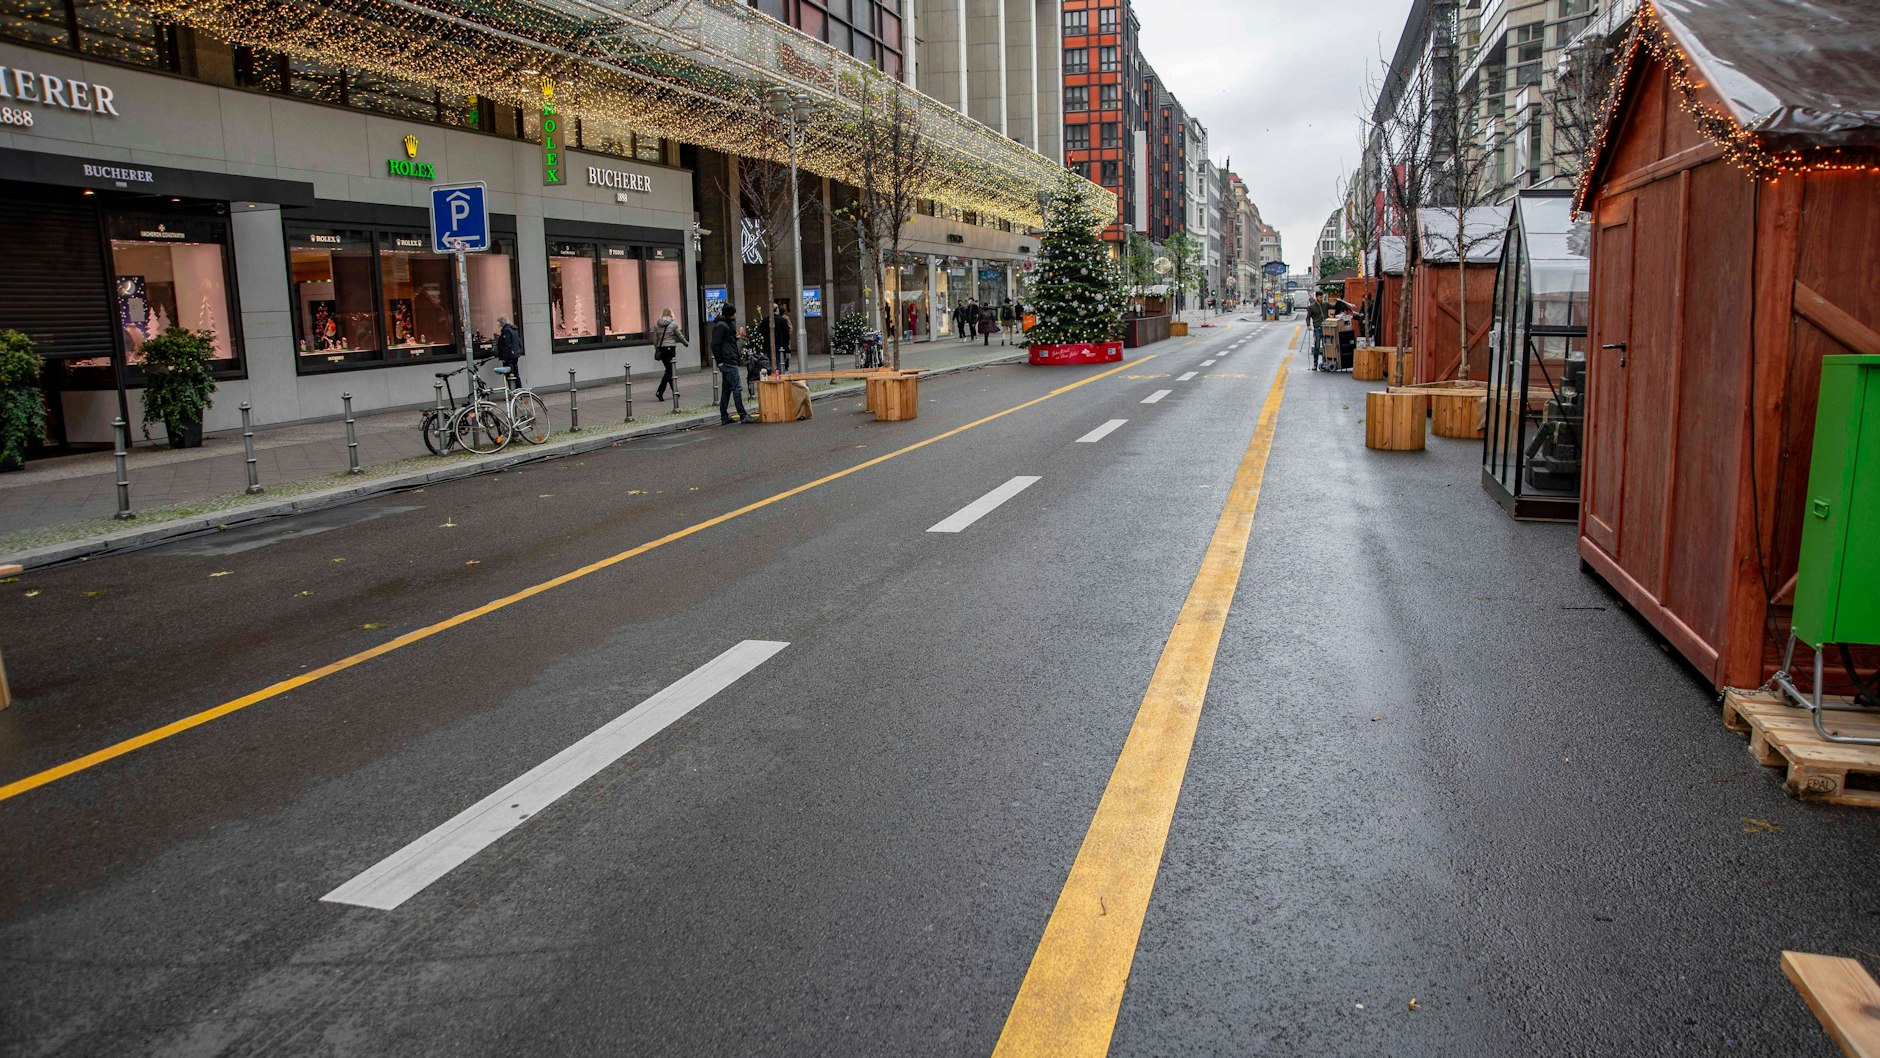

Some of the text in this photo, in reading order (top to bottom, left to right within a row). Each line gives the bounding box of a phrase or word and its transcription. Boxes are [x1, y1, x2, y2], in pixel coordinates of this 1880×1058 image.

[83, 164, 154, 182] BUCHERER
[389, 160, 436, 178] ROLEX
[588, 166, 652, 192] BUCHERER
[450, 200, 470, 231] P
[316, 235, 336, 243] ROLEX
